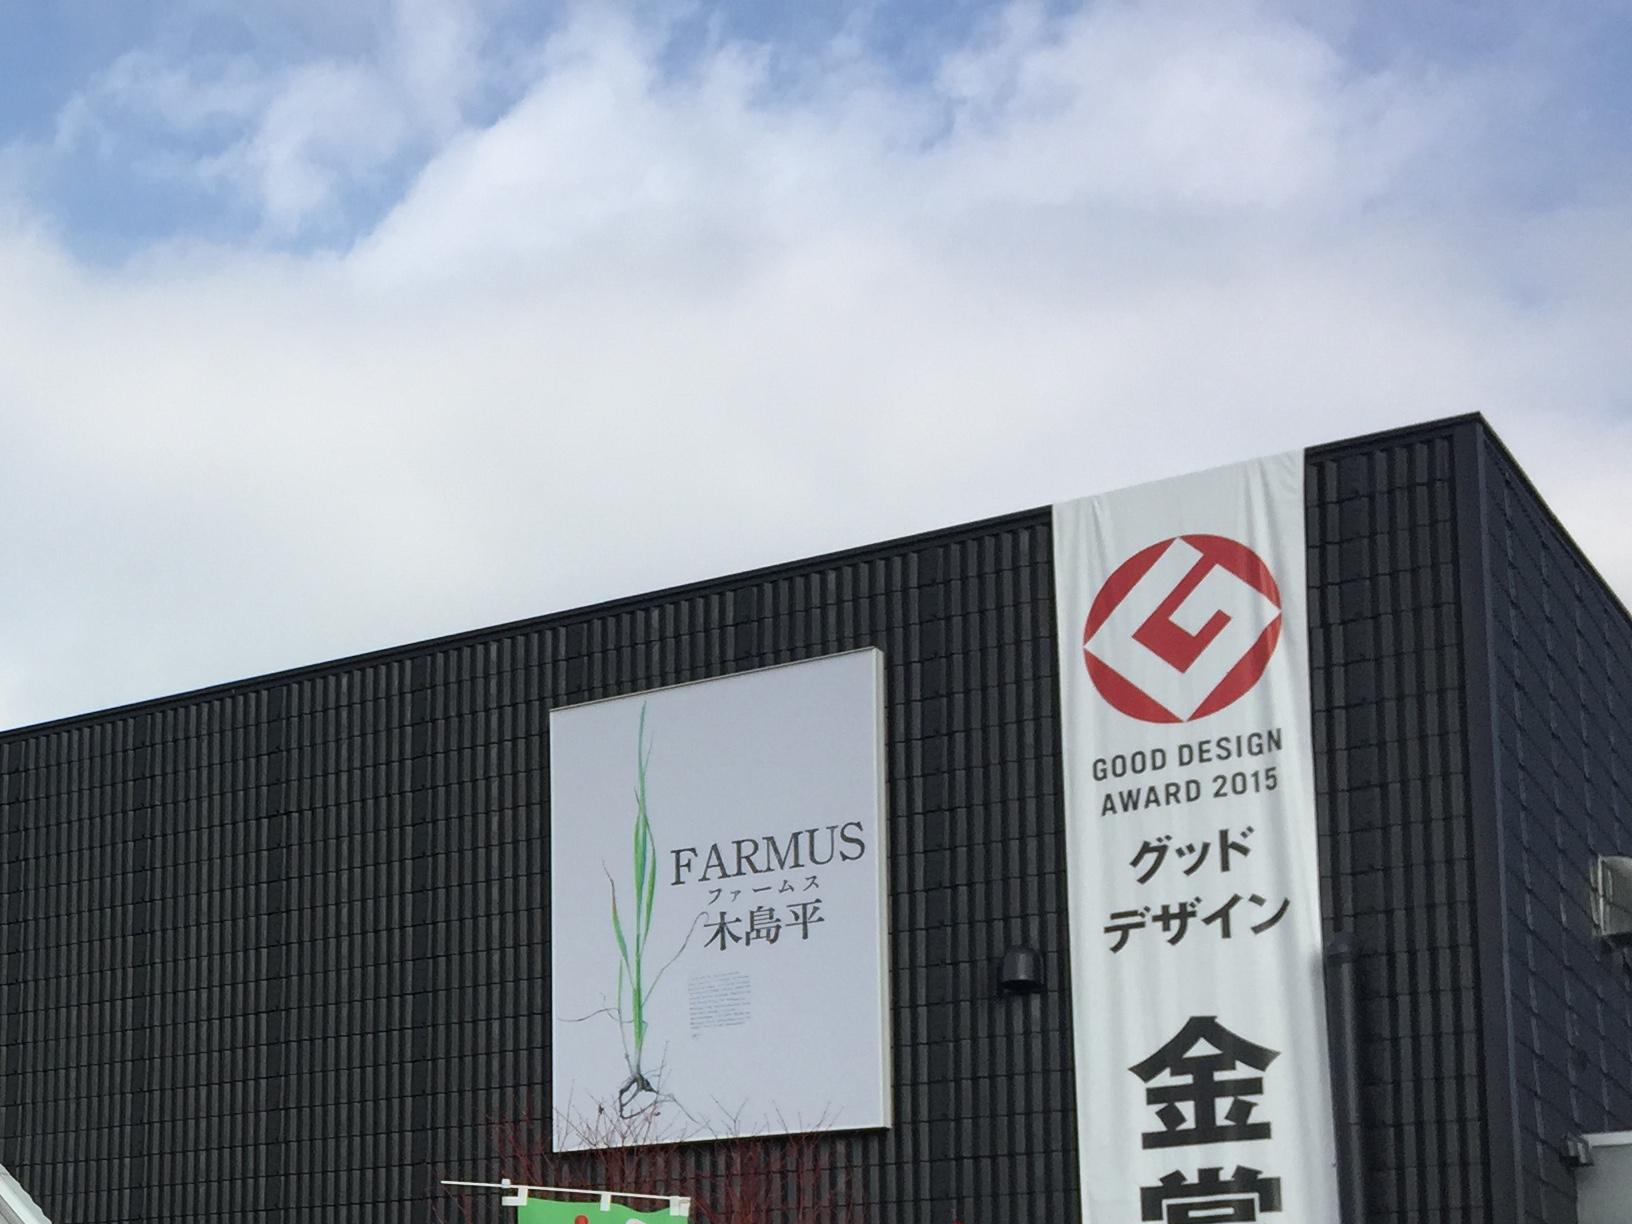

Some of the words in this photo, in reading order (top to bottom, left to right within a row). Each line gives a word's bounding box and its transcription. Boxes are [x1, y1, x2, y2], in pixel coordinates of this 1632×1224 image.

[1093, 748, 1166, 781] GOOD
[1179, 728, 1283, 766] DESIGN
[1101, 779, 1200, 816] AWARD
[1213, 767, 1278, 797] 2015
[671, 822, 866, 886] FARMUS
[1130, 826, 1254, 884] グッド
[708, 875, 819, 905] ファームス
[704, 898, 825, 951] 木島平
[1104, 894, 1290, 953] デザイン
